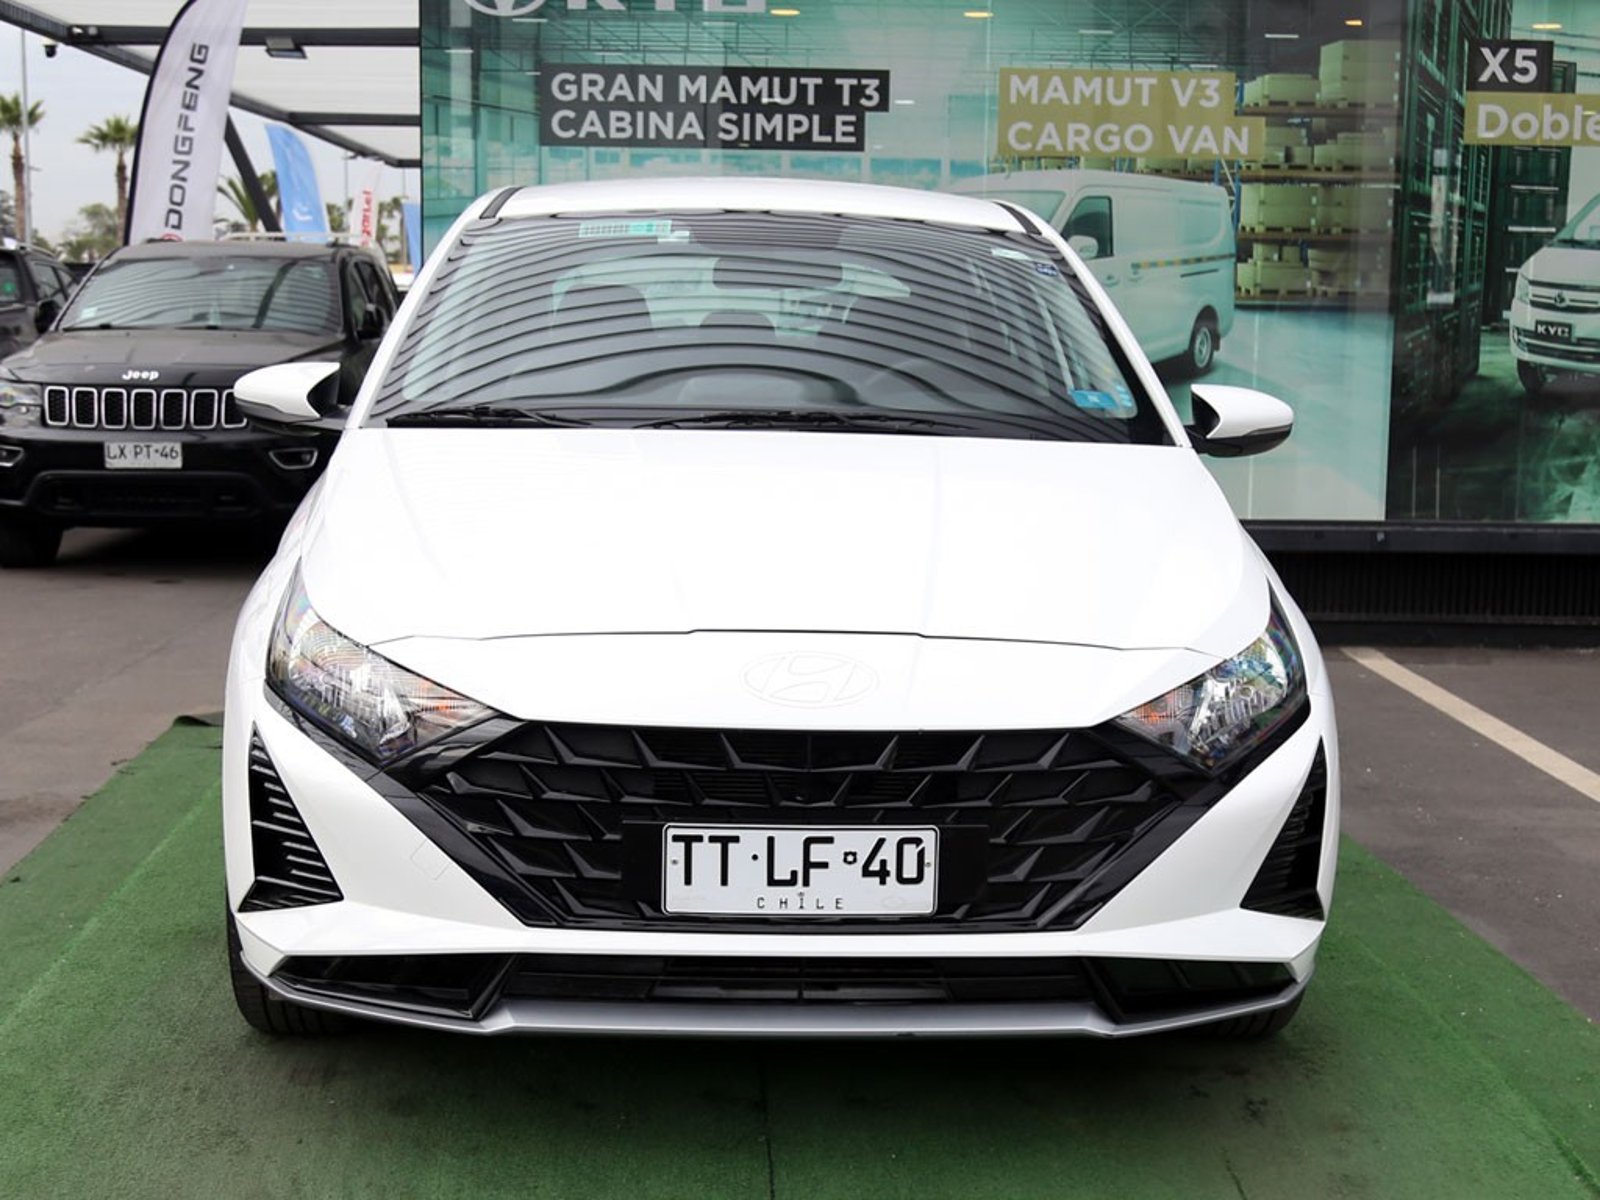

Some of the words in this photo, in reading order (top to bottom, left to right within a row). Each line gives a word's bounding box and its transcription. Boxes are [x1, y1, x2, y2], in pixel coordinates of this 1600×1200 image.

[1478, 47, 1538, 84] X5
[551, 72, 663, 103] GRAN
[679, 74, 822, 106] MAMUT
[835, 78, 880, 107] T3
[1010, 74, 1158, 107] MAMUT
[1171, 78, 1221, 108] V3
[165, 43, 209, 230] DONGFENG
[551, 109, 705, 140] CABINA
[718, 112, 857, 143] SIMPLE
[1008, 121, 1154, 153] CARGO
[1168, 125, 1249, 155] VAN
[121, 370, 159, 381] Jeep
[757, 896, 843, 910] CHILE
